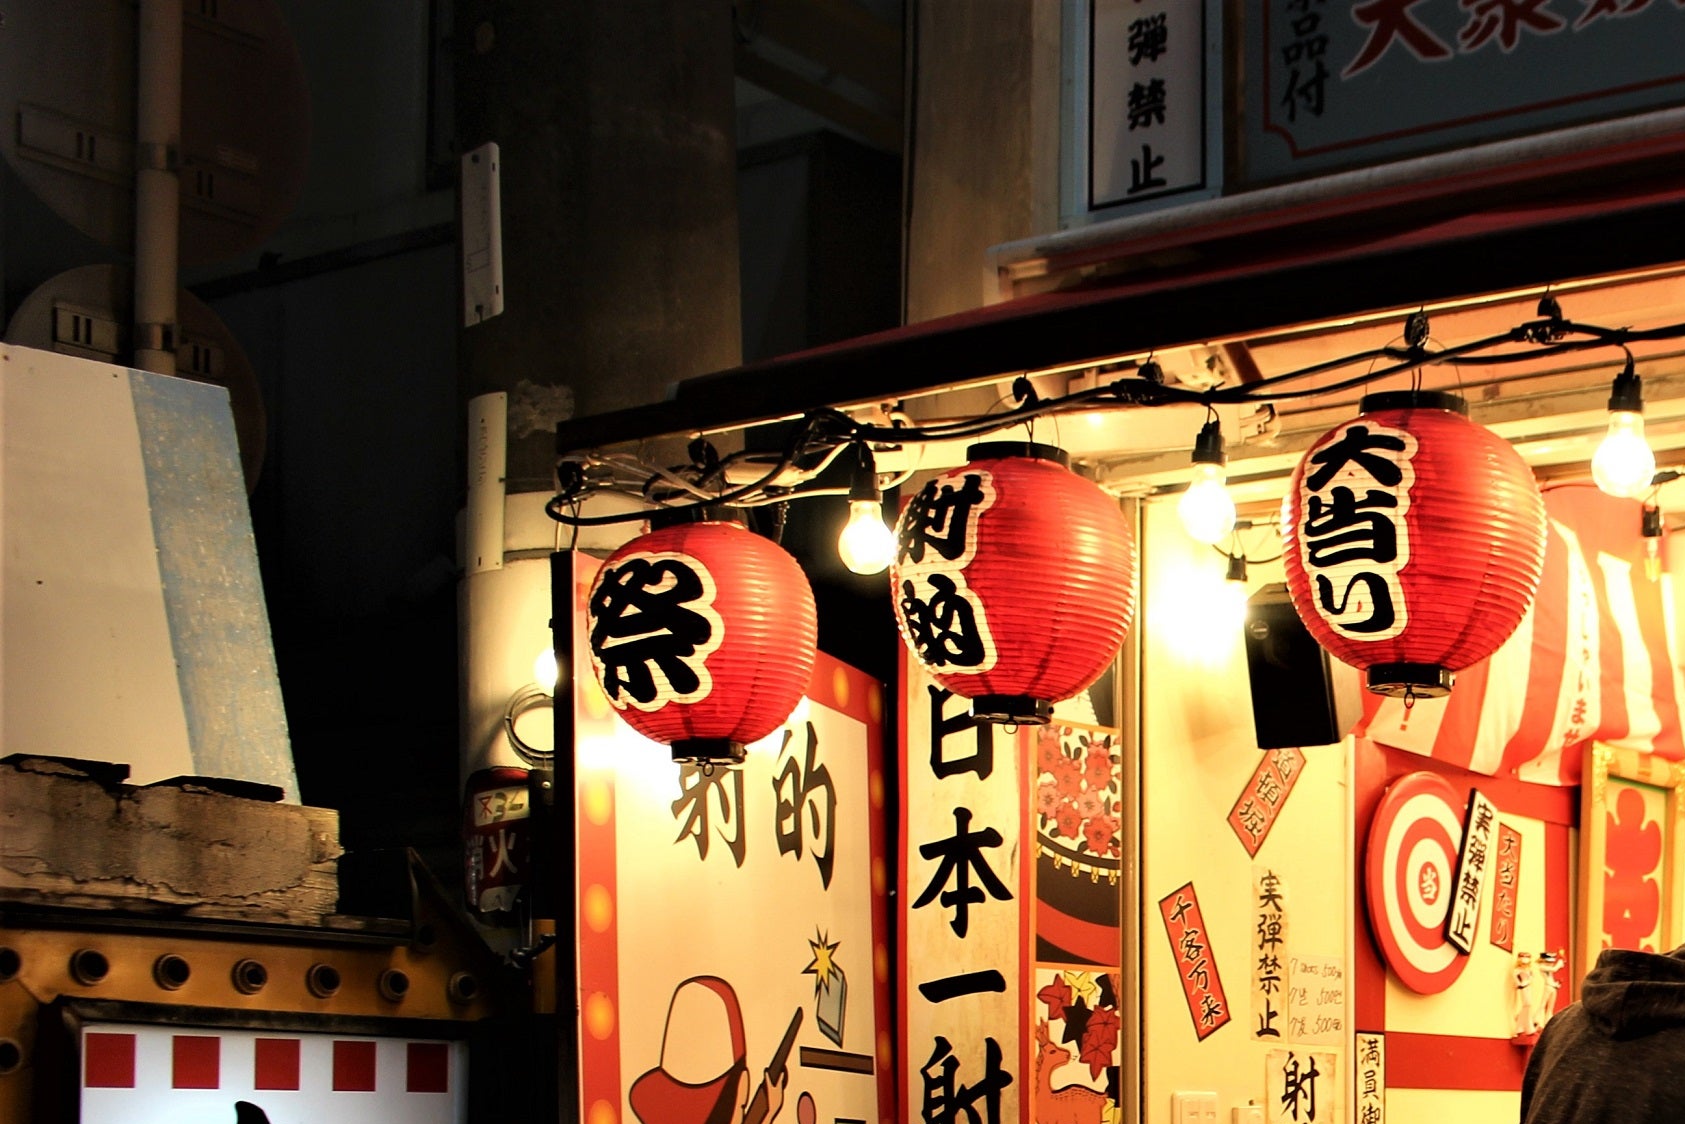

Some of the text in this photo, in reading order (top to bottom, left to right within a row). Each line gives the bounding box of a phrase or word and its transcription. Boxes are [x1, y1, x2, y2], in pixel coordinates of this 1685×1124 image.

[1128, 0, 1168, 194] 弾禁止
[589, 557, 713, 702] 祭
[898, 474, 986, 667] 射的
[1420, 863, 1439, 901] 当
[1452, 801, 1494, 946] 実弾禁止
[1495, 832, 1519, 945] 大当たり
[1169, 895, 1223, 1031] 千客万来
[1256, 867, 1285, 1038] 実弾禁止
